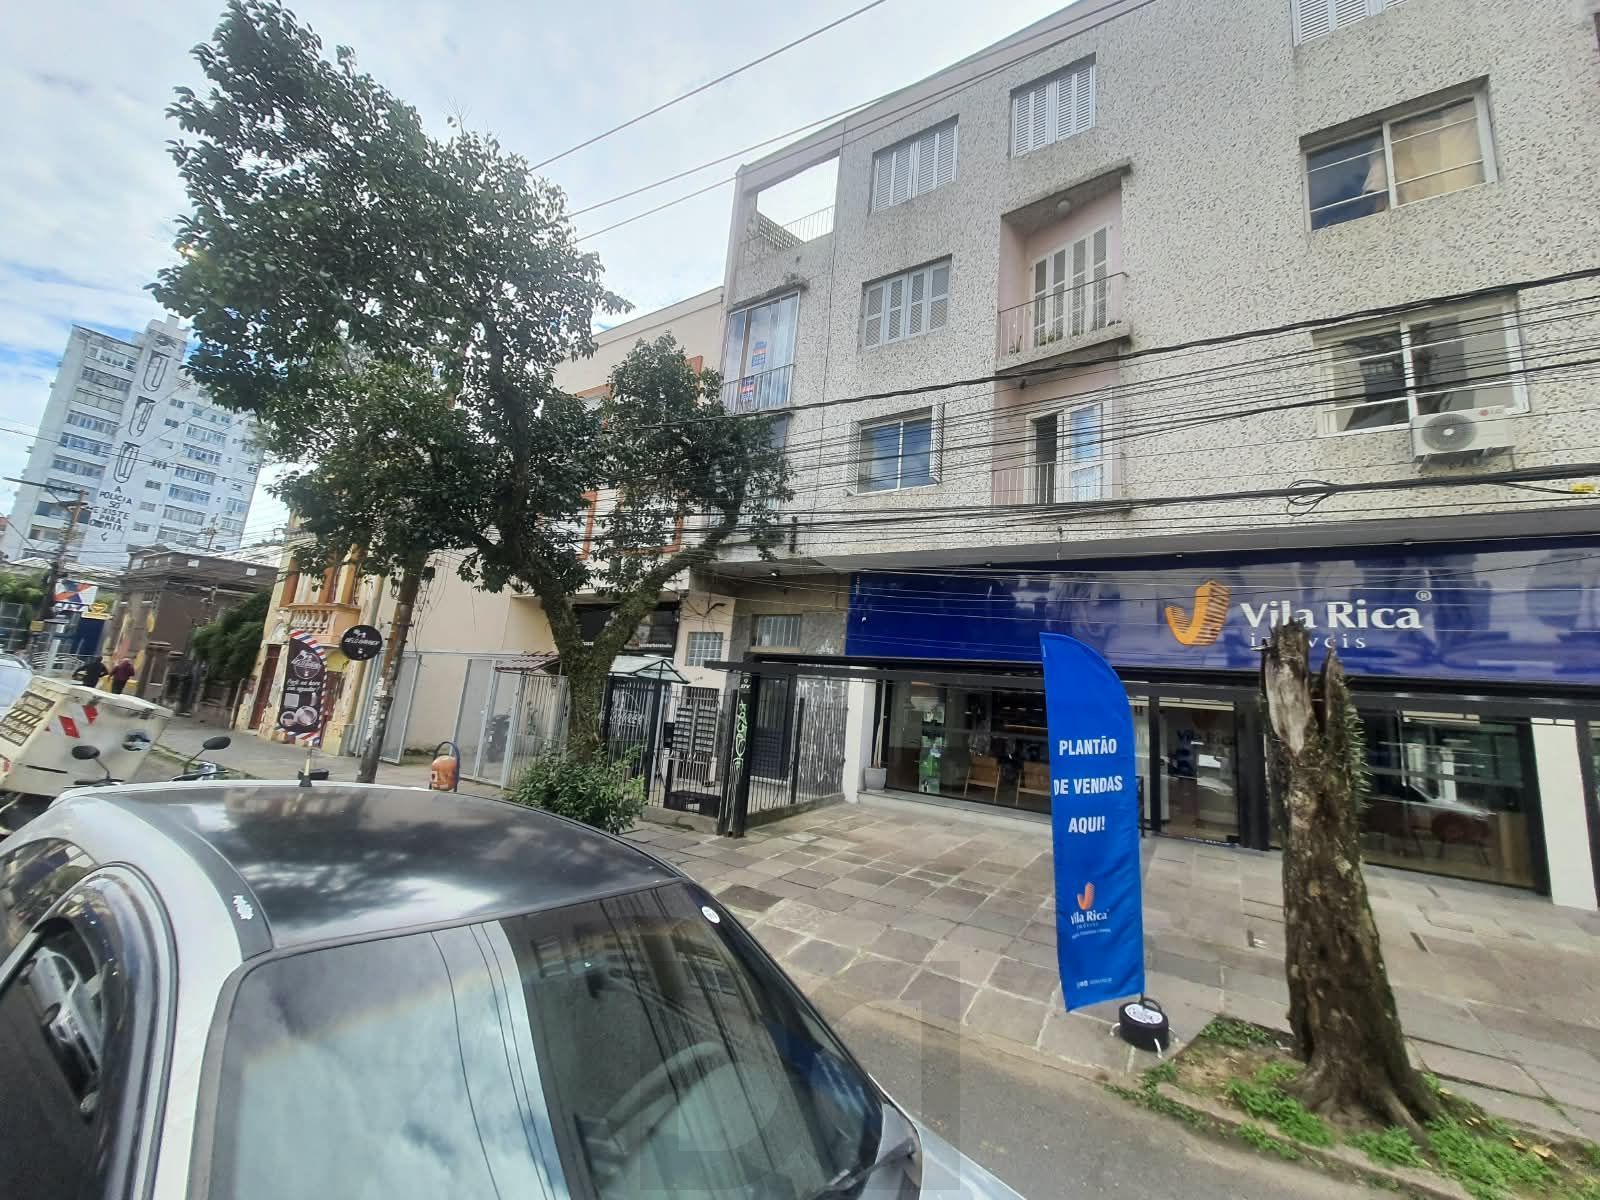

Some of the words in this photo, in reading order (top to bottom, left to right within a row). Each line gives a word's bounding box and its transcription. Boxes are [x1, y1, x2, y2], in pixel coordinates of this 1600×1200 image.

[1240, 600, 1318, 629] Vila
[1327, 599, 1424, 629] Rica
[1059, 736, 1117, 756] PLANTÃO
[1053, 779, 1069, 796] DE
[1073, 775, 1123, 795] VENDAS
[1068, 816, 1105, 834] AQUI!
[1086, 909, 1108, 922] Rica
